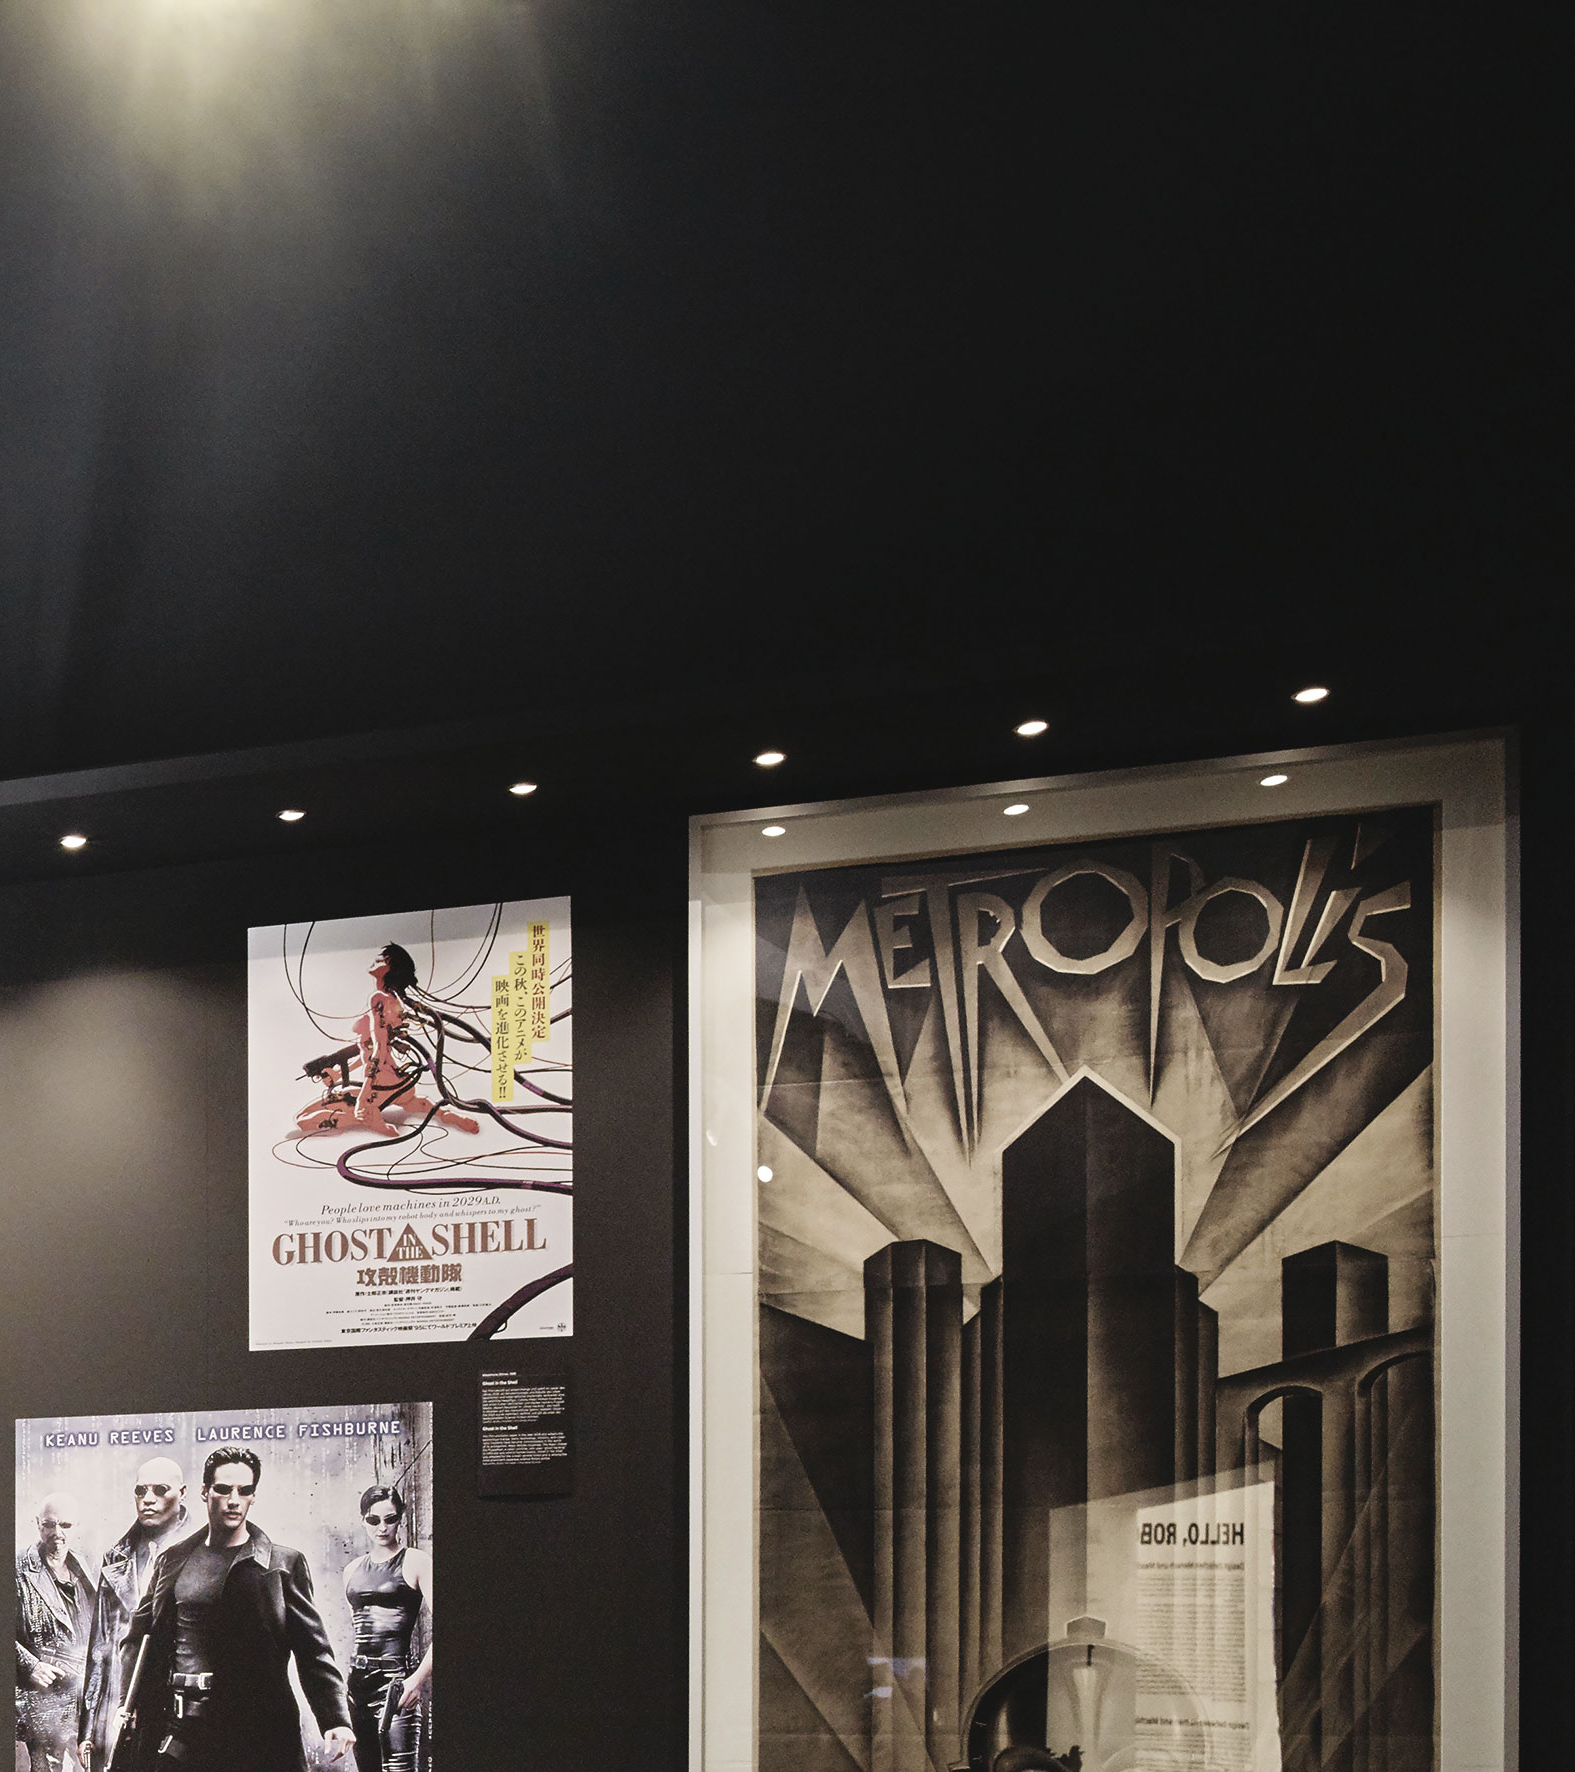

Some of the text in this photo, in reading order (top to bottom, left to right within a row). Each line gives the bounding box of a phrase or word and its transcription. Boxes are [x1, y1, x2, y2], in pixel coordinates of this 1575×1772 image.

[531, 925, 546, 1039] 世界同時公開決定
[756, 824, 1411, 1155] METROPOLIS
[321, 1203, 357, 1216] People
[358, 1202, 381, 1213] love
[383, 1199, 436, 1211] machines
[439, 1198, 450, 1208] in
[272, 1228, 392, 1265] GHOST
[402, 1234, 416, 1247] IN
[431, 1218, 547, 1256] SHELL
[397, 1246, 423, 1259] THE
[356, 1264, 462, 1287] 攻殻機動隊
[45, 1419, 401, 1447] KEANU REEVES LAURENCE FISHBURNE
